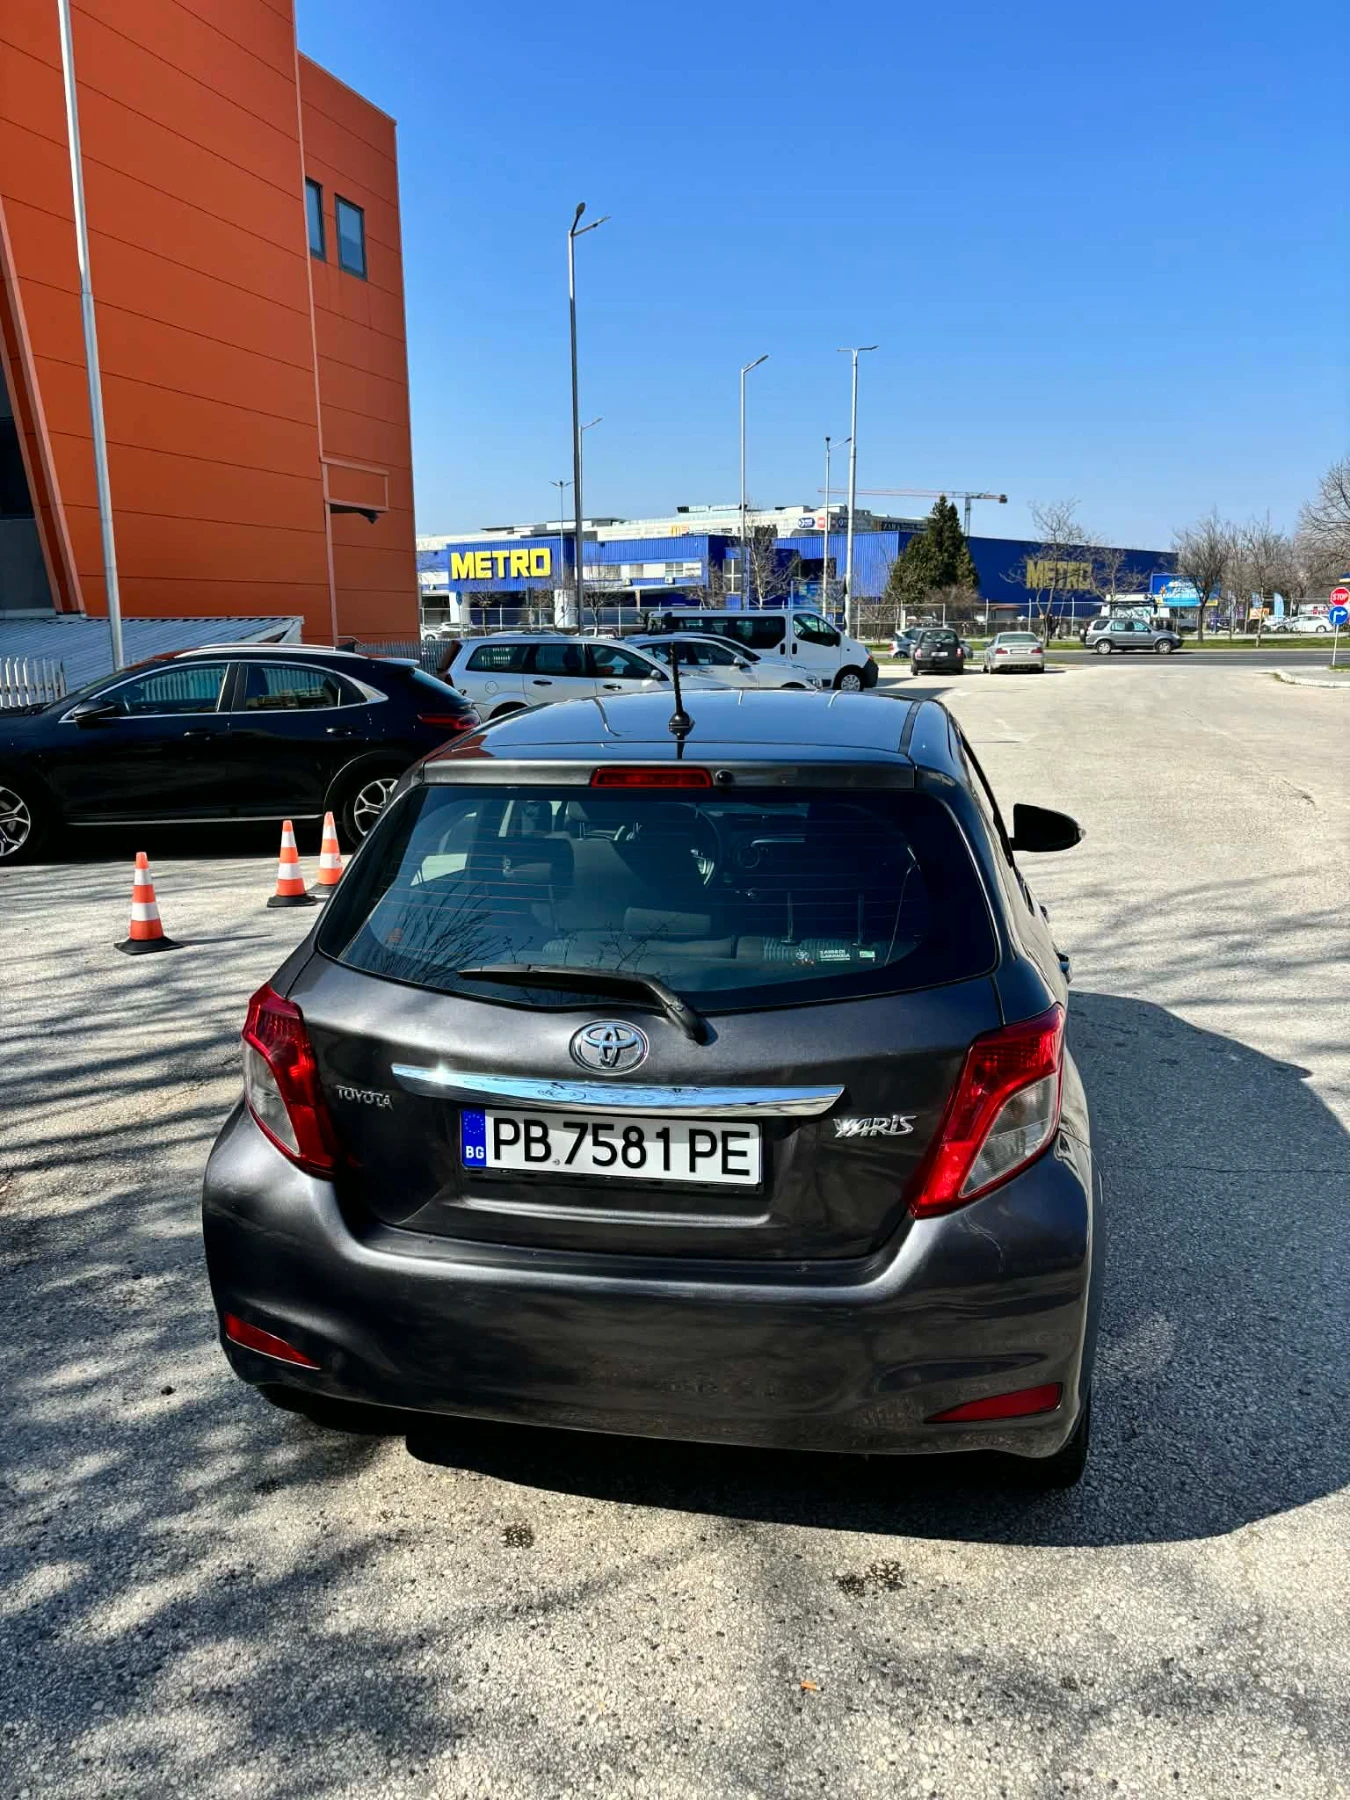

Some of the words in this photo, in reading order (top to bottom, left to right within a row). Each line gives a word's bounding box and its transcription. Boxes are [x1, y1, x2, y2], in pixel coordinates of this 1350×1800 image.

[451, 548, 551, 580] METRO
[1026, 559, 1092, 590] METRO
[335, 1085, 394, 1111] TOYOTA
[465, 1146, 485, 1160] BG
[493, 1117, 553, 1163] PB
[562, 1121, 672, 1172] 7581
[687, 1129, 751, 1177] PE
